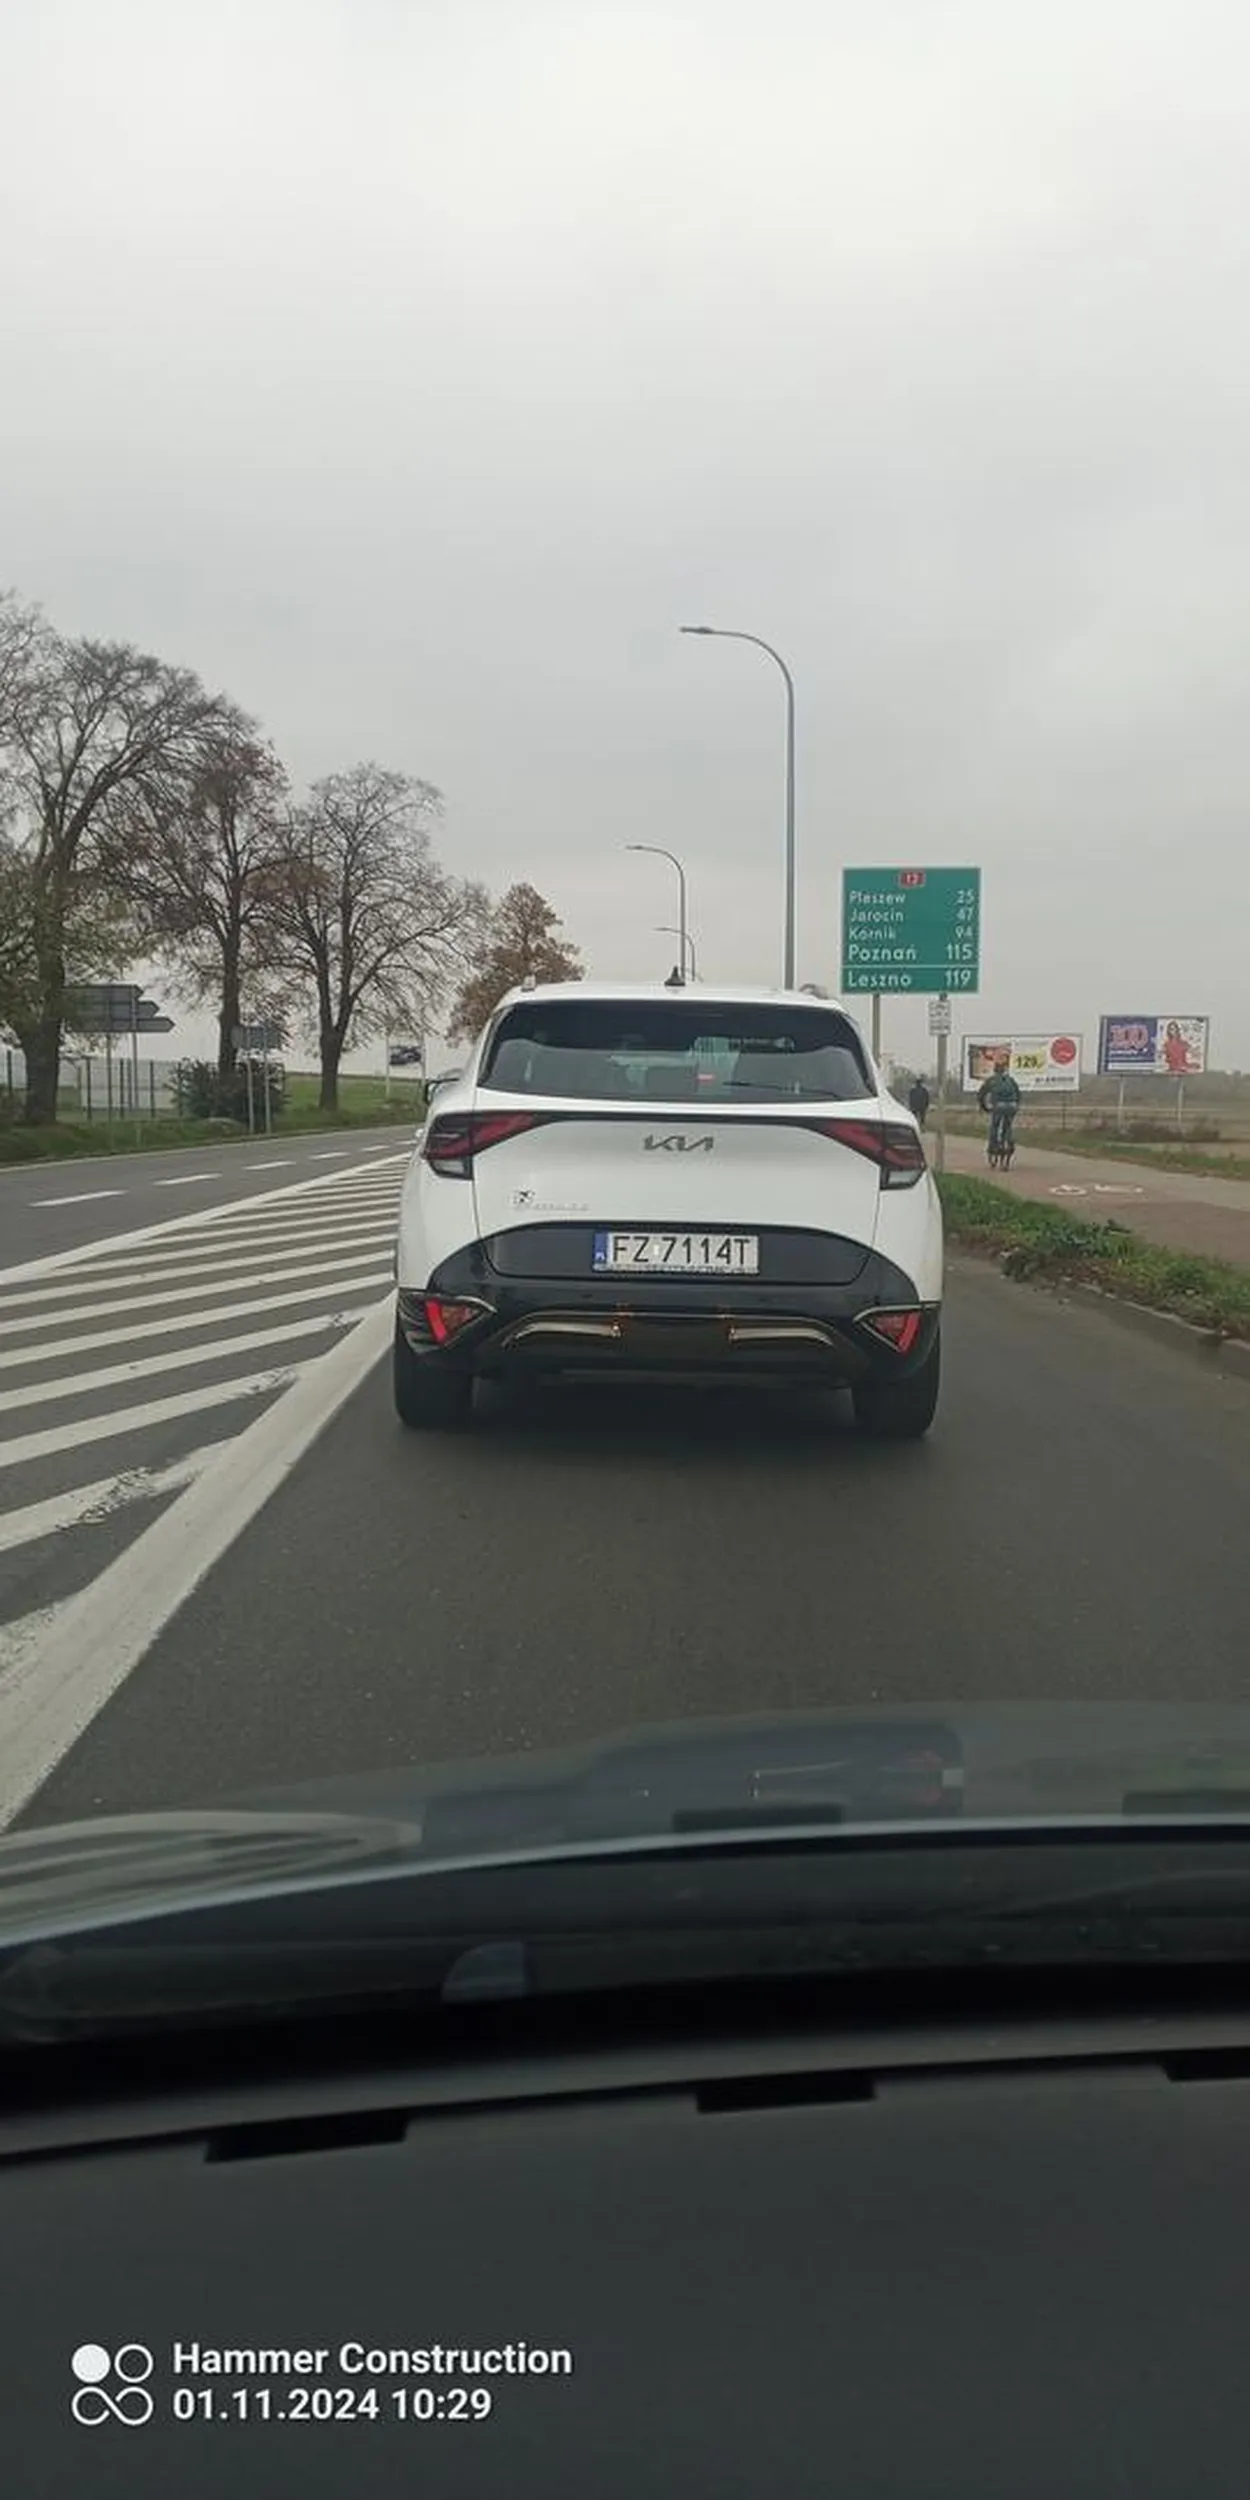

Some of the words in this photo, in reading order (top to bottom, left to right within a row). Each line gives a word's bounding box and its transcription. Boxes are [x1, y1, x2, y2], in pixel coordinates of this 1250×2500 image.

[849, 890, 906, 904] Pleszew
[956, 889, 976, 905] 25
[851, 908, 904, 922] Jarocin
[957, 907, 974, 921] 47
[955, 926, 973, 939] 94
[848, 943, 917, 961] Poznań
[946, 943, 973, 961] 115
[848, 970, 912, 987] Leszno
[945, 969, 972, 986] 119
[613, 1235, 650, 1263] FZ
[661, 1236, 750, 1265] 7114T
